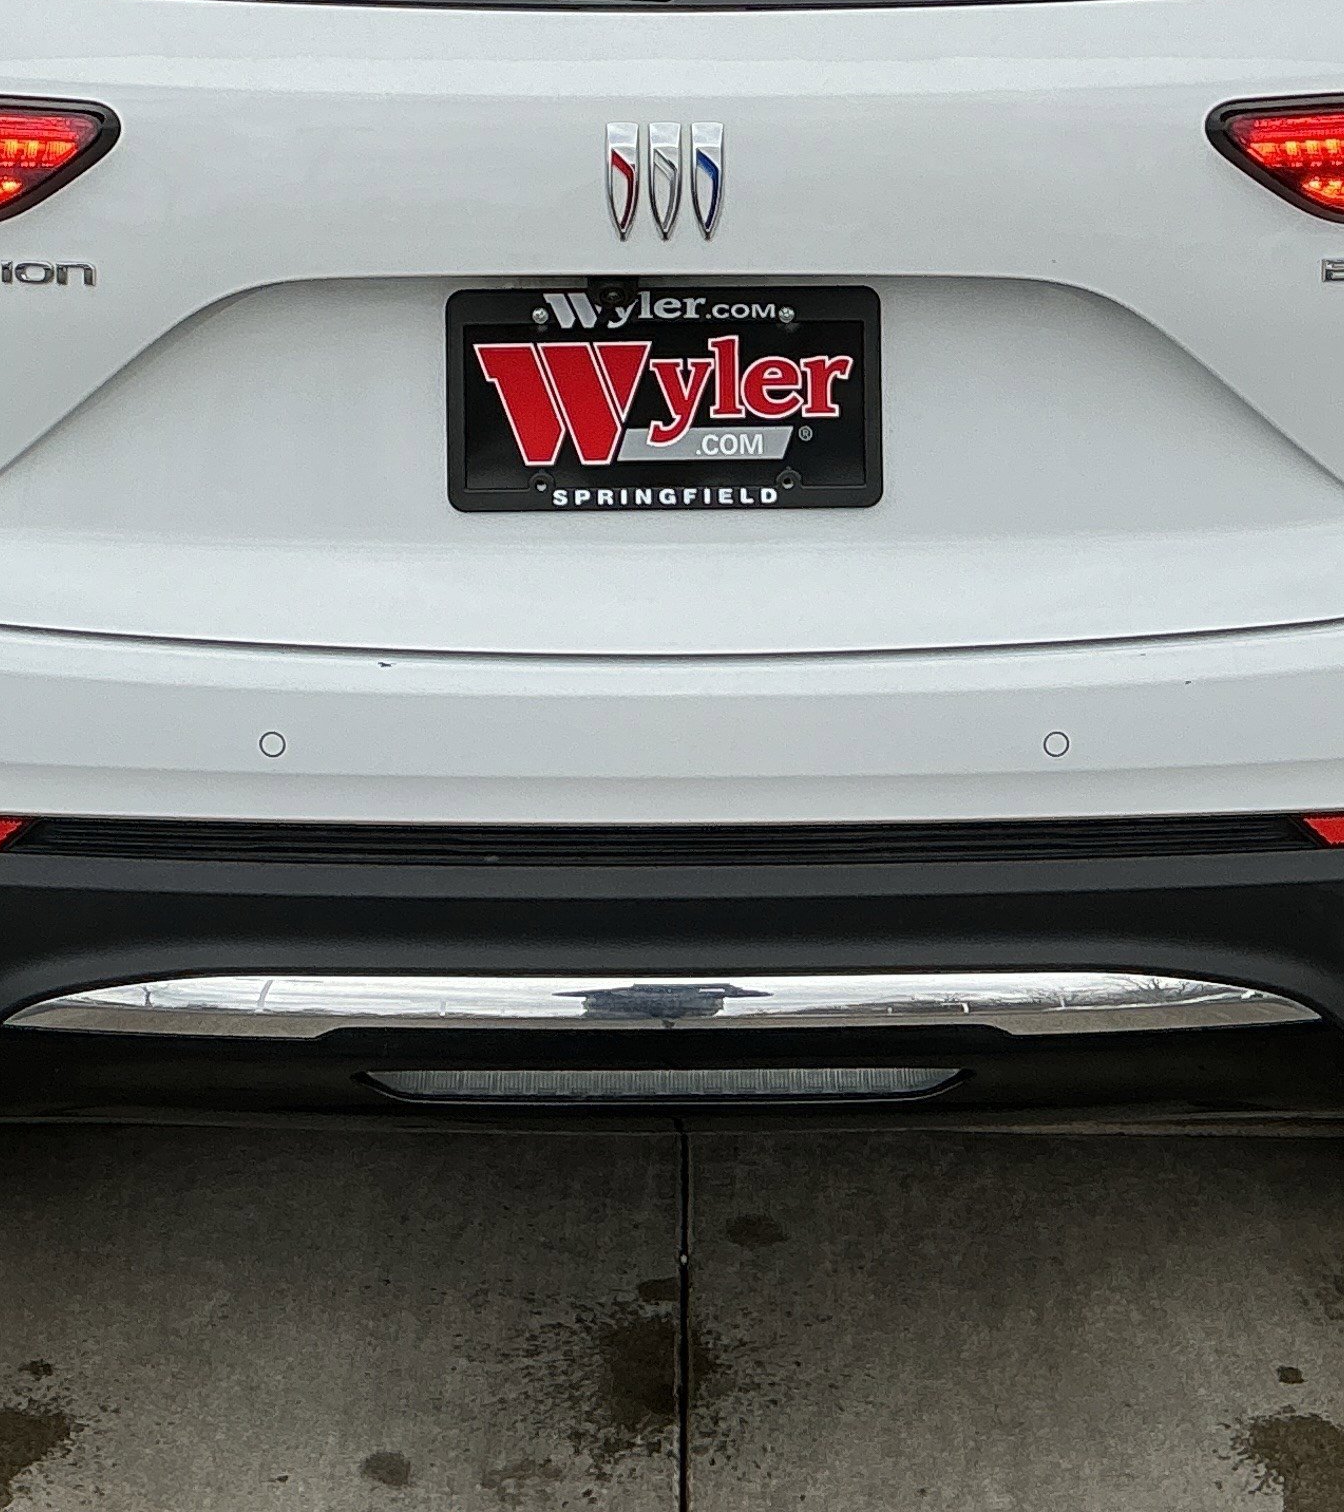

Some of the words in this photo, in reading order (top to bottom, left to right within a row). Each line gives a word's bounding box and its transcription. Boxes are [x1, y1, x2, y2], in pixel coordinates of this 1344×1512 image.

[473, 335, 853, 467] Wyler
[696, 433, 764, 456] .COM
[552, 488, 779, 505] SPRINGFIELD
